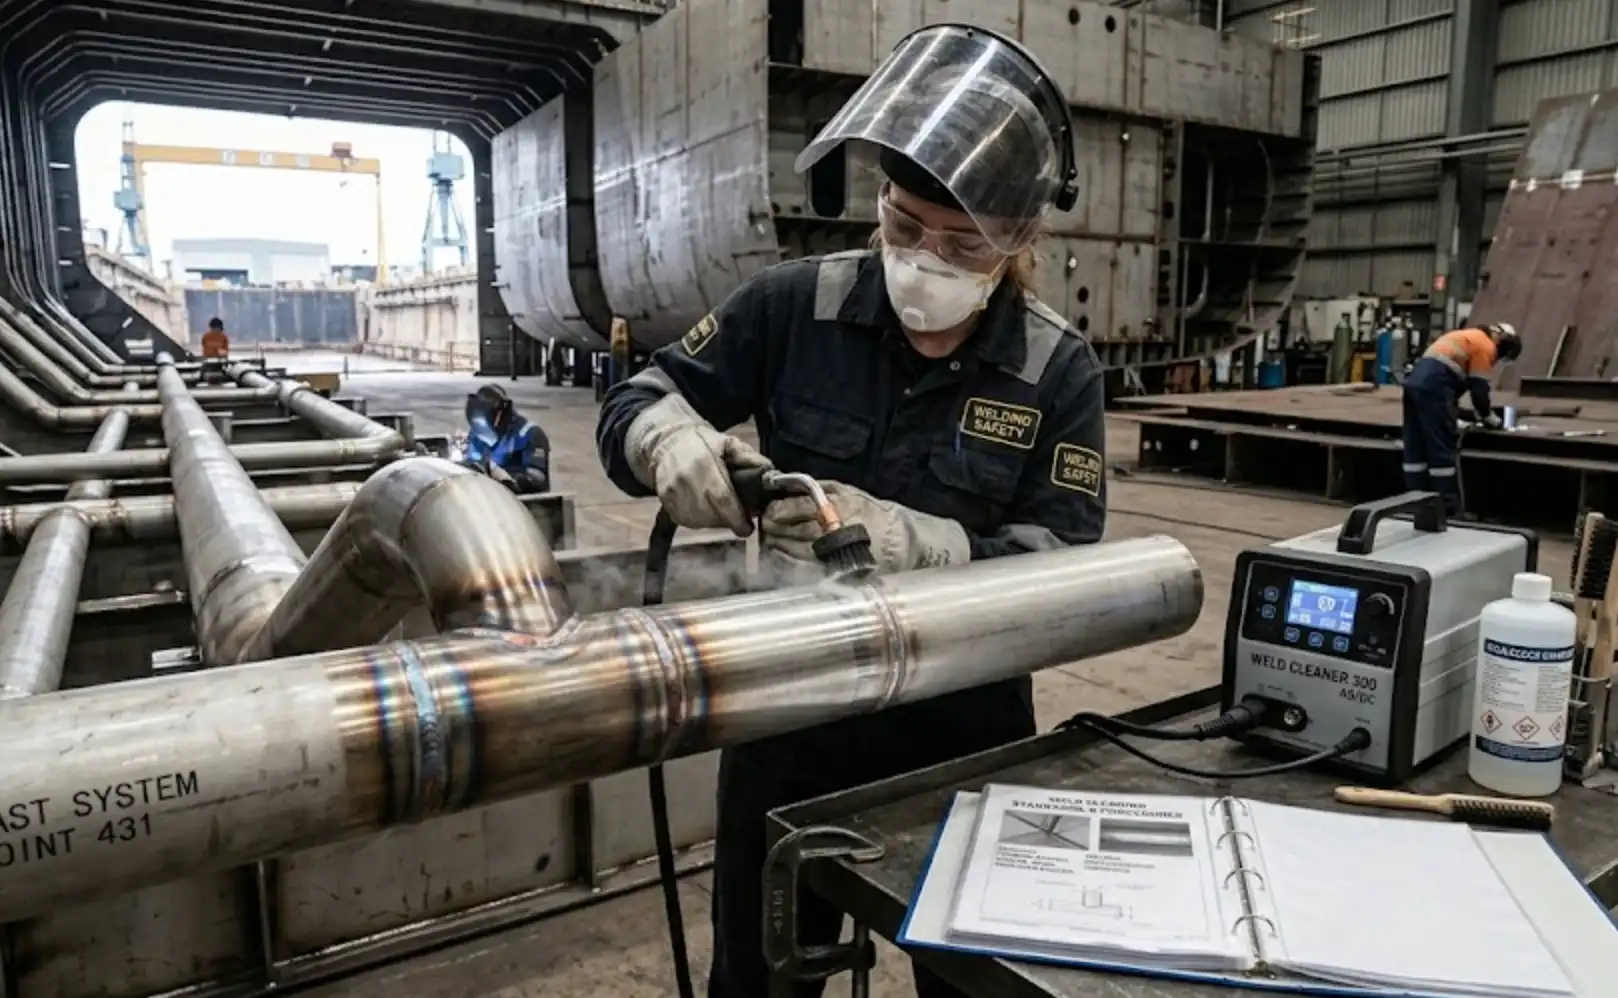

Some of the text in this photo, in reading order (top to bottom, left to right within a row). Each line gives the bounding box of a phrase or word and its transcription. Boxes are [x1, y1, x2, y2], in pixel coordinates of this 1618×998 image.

[1251, 652, 1286, 671] WELD
[1290, 661, 1349, 685] CLEANER
[72, 769, 199, 818] SYSTEM
[97, 811, 151, 844] 431
